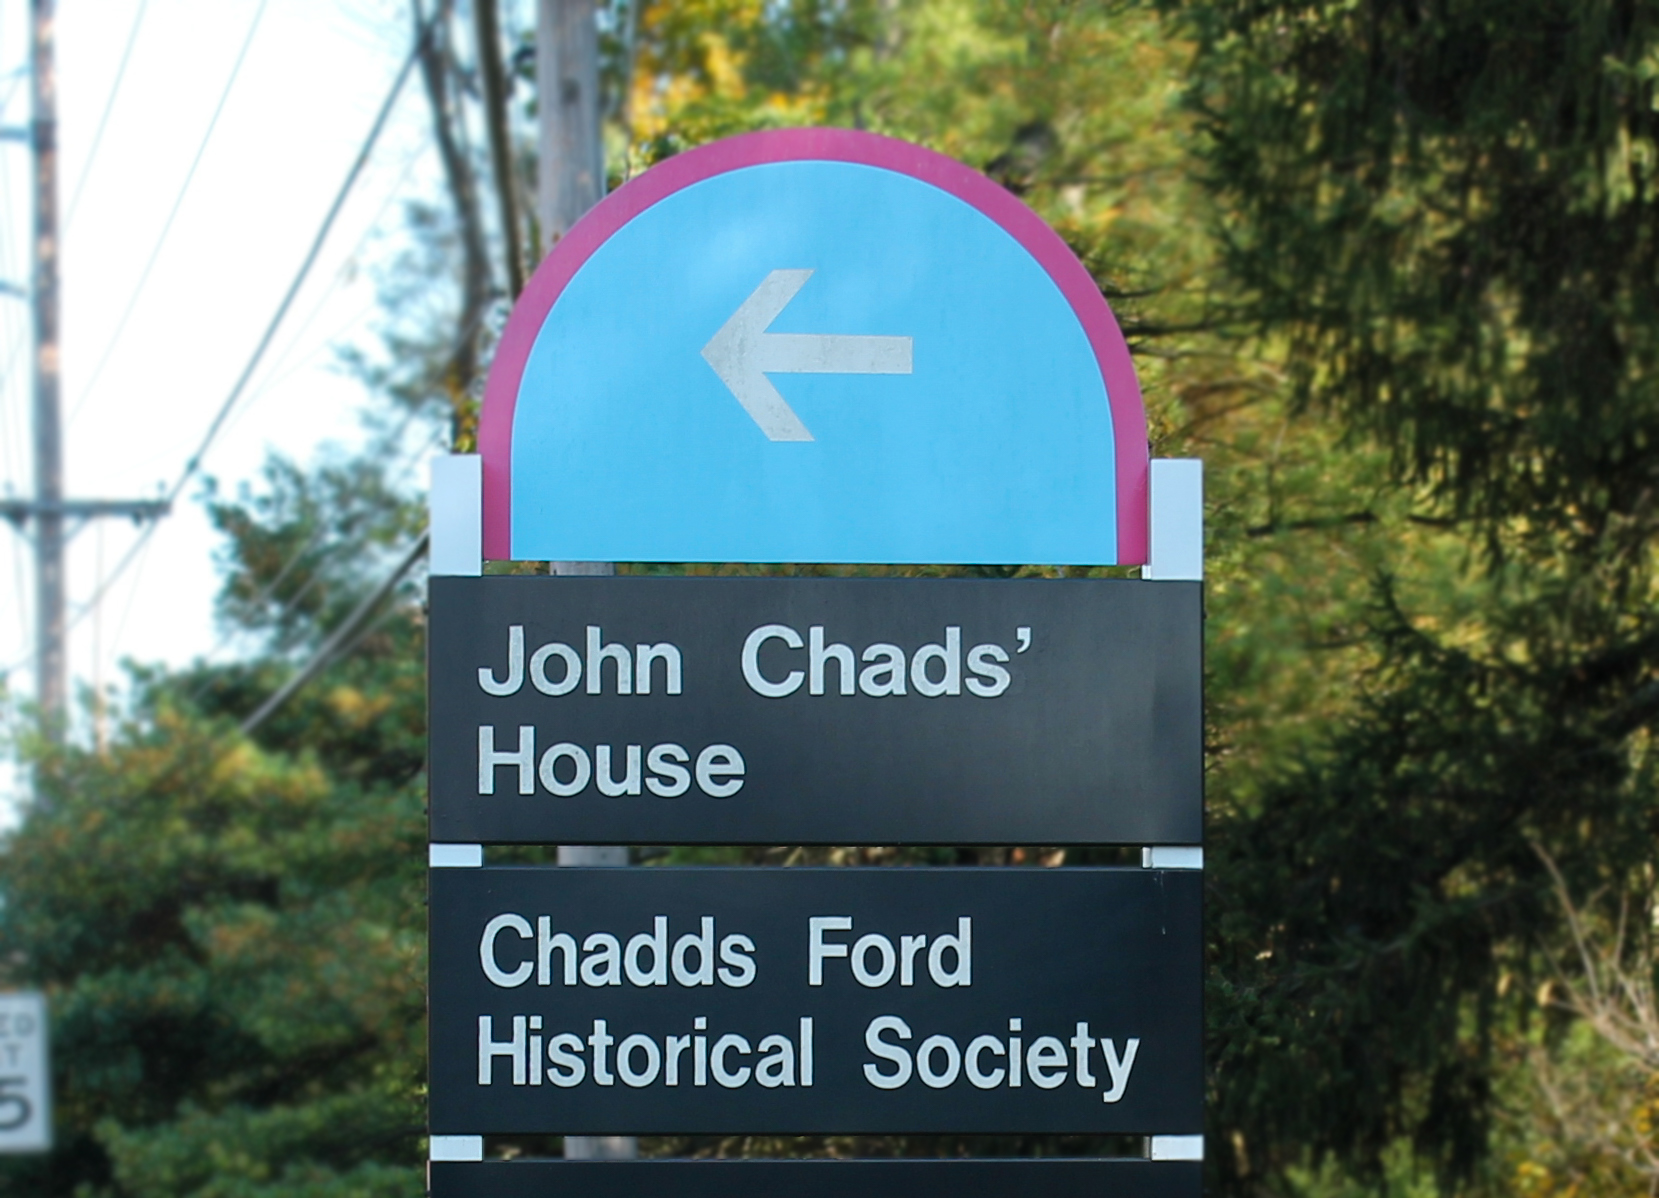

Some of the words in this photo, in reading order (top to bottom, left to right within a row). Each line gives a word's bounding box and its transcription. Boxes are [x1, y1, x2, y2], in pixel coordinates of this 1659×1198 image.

[479, 626, 682, 696] John
[741, 625, 1031, 697] Chads'
[478, 725, 745, 797] House
[479, 913, 756, 988] Chadds
[809, 916, 972, 988] Ford
[477, 1015, 813, 1088] Historical
[863, 1016, 1140, 1103] Society
